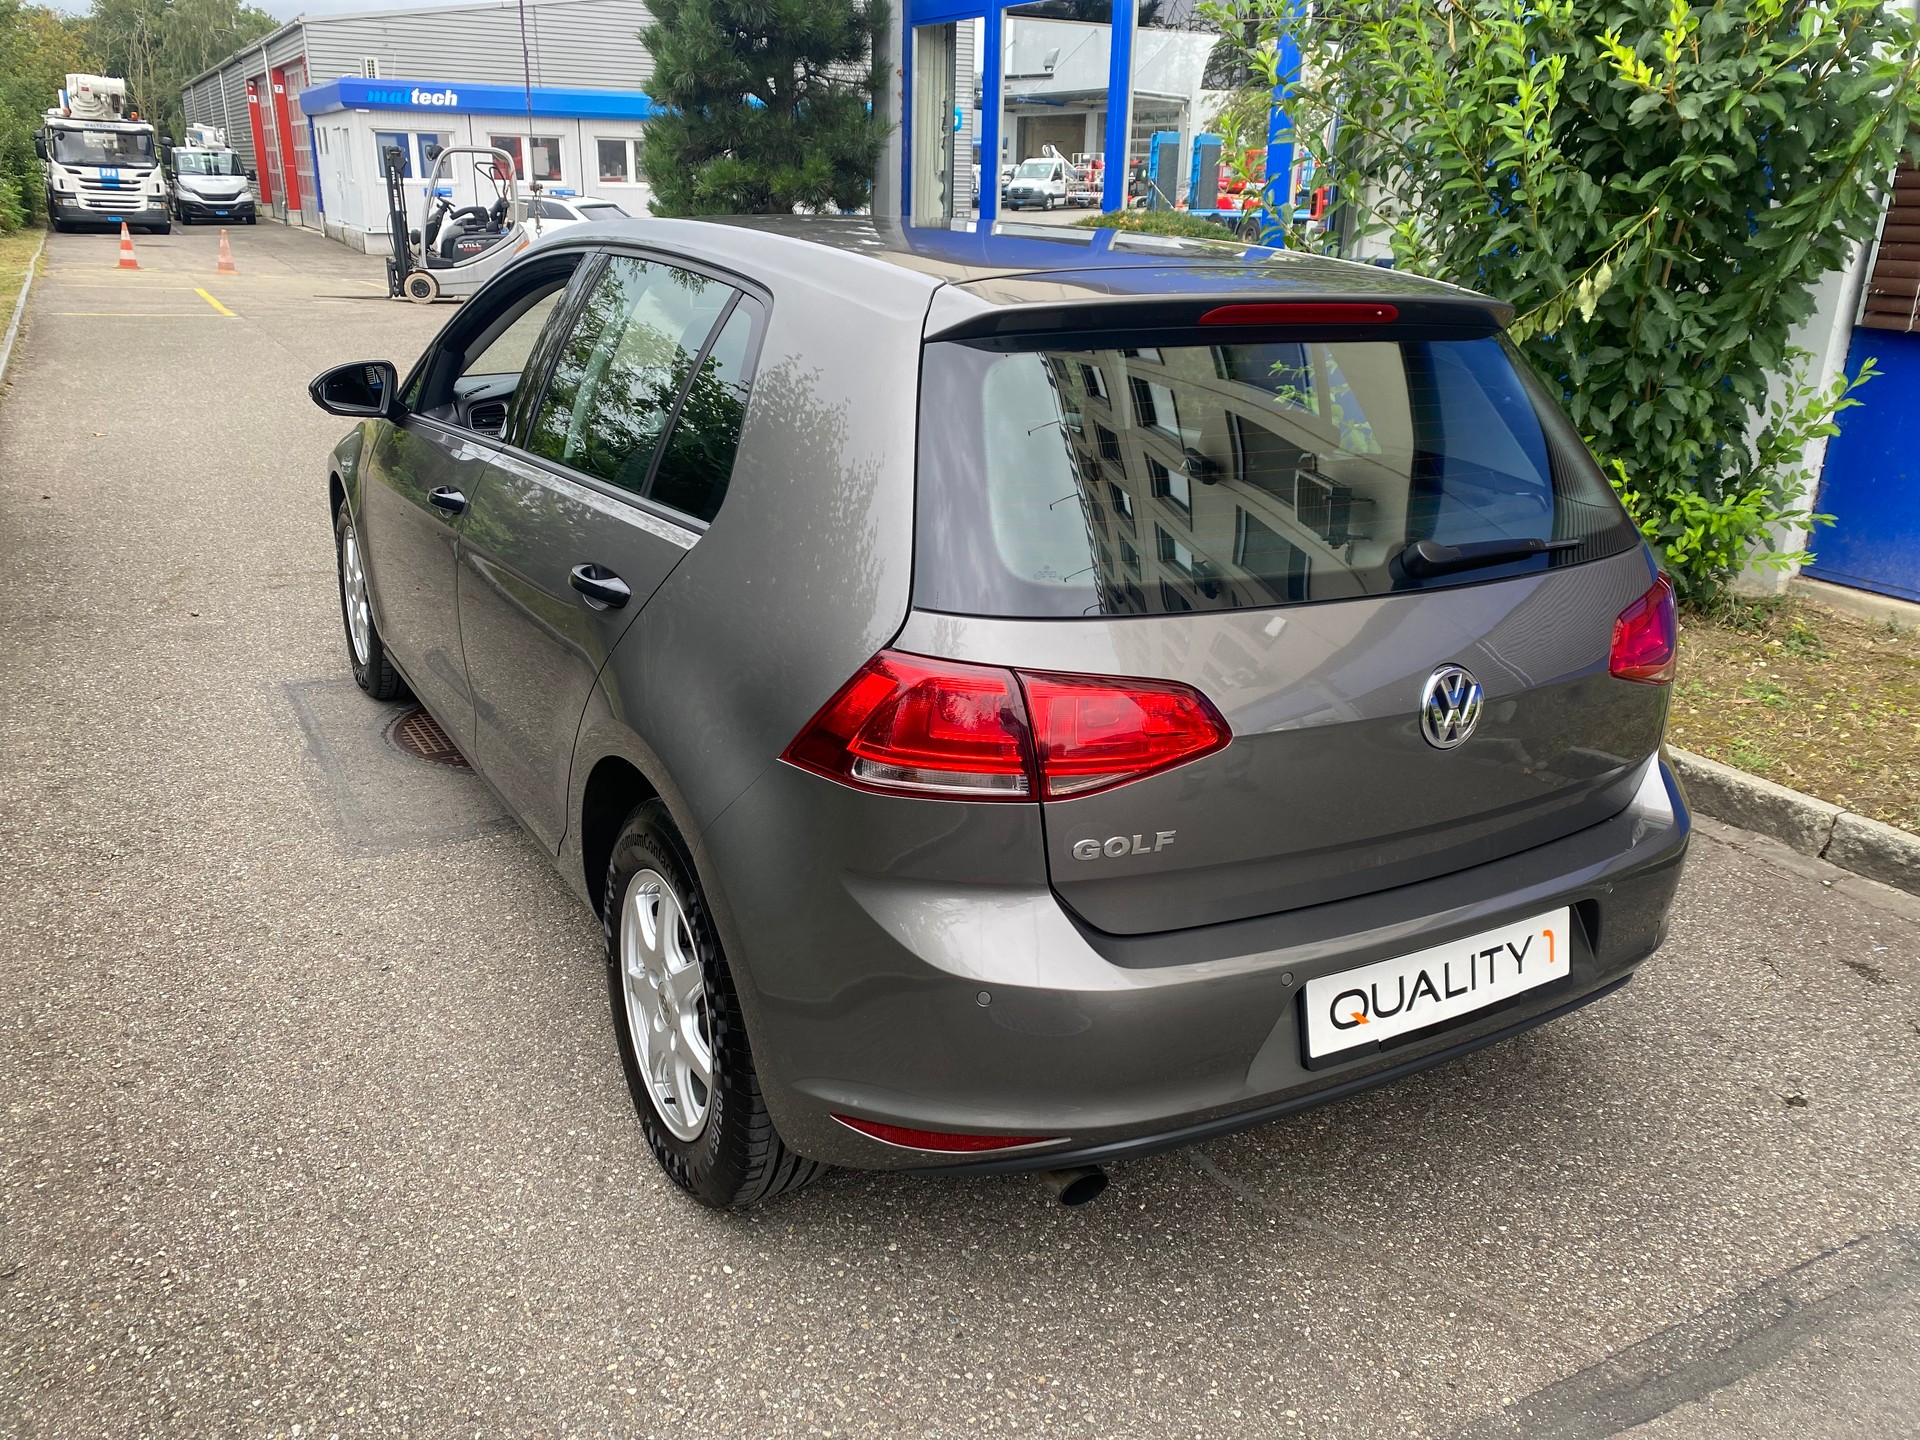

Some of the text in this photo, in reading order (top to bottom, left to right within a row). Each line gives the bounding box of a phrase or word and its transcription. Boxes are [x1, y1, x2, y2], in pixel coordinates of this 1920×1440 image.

[366, 88, 458, 106] maltech
[1072, 830, 1177, 860] GOLF
[1329, 929, 1555, 1030] QUALITY 1
